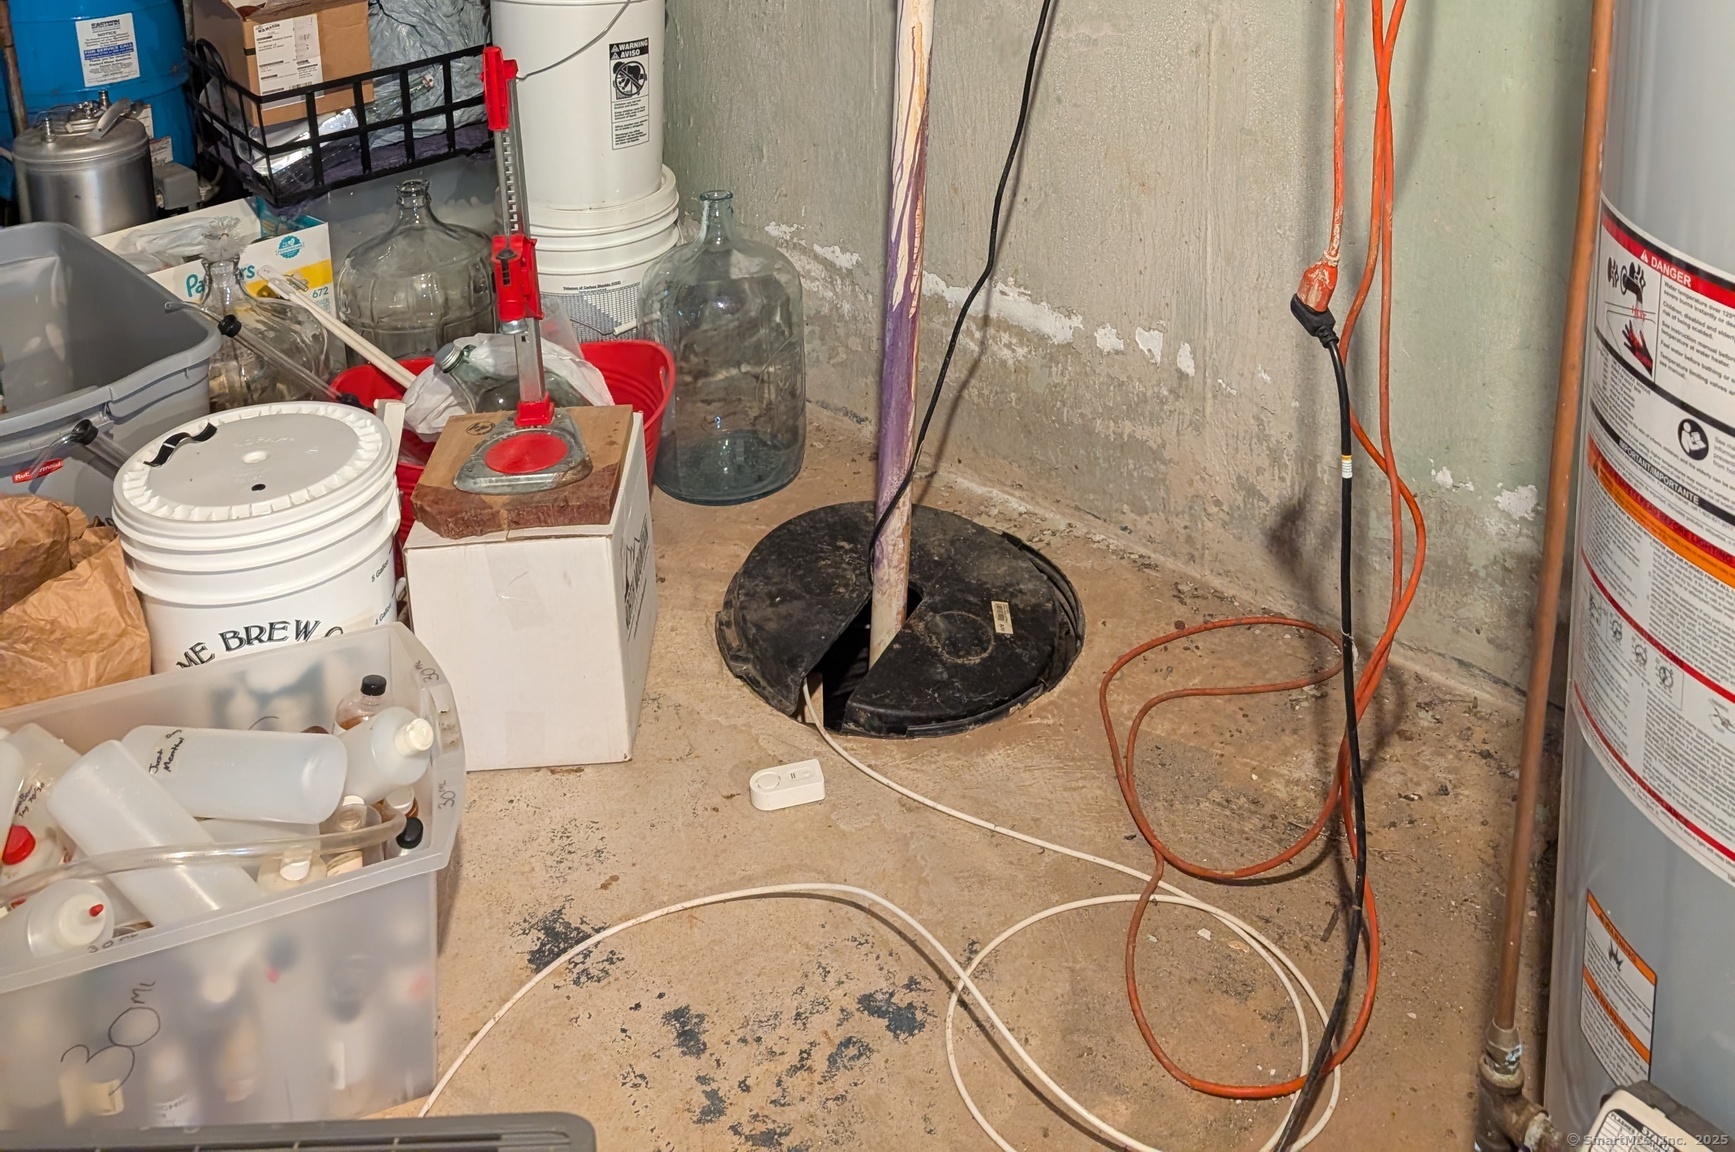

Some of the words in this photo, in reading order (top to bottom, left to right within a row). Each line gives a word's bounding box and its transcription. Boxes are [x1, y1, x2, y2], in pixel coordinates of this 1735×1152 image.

[619, 40, 648, 50] WARNING
[621, 50, 640, 58] AVISO
[186, 264, 255, 298] Pars
[1651, 256, 1692, 288] DANGER
[312, 286, 329, 298] 672
[1677, 288, 1707, 308] temperature
[1708, 304, 1720, 314] over
[1663, 289, 1678, 301] severe
[1679, 297, 1692, 309] burns
[1694, 304, 1716, 321] instantly
[1677, 317, 1690, 330] being
[1692, 325, 1713, 340] scalded.
[1683, 312, 1705, 327] disabled
[1706, 324, 1716, 333] and
[1661, 327, 1688, 347] temperature
[1696, 348, 1709, 358] water
[1670, 325, 1696, 344] instruction
[1697, 341, 1716, 354] manual
[1659, 350, 1687, 372] Temperature
[1689, 368, 1707, 384] limiting
[1709, 378, 1726, 392] valves
[1668, 364, 1685, 378] manual.
[1670, 346, 1683, 357] water
[1684, 353, 1700, 366] before
[1701, 362, 1721, 379] bathing
[376, 559, 389, 579] Gallon
[379, 603, 392, 622] Gallon
[218, 619, 322, 652] BREW
[1610, 1113, 1636, 1134] FLASHES
